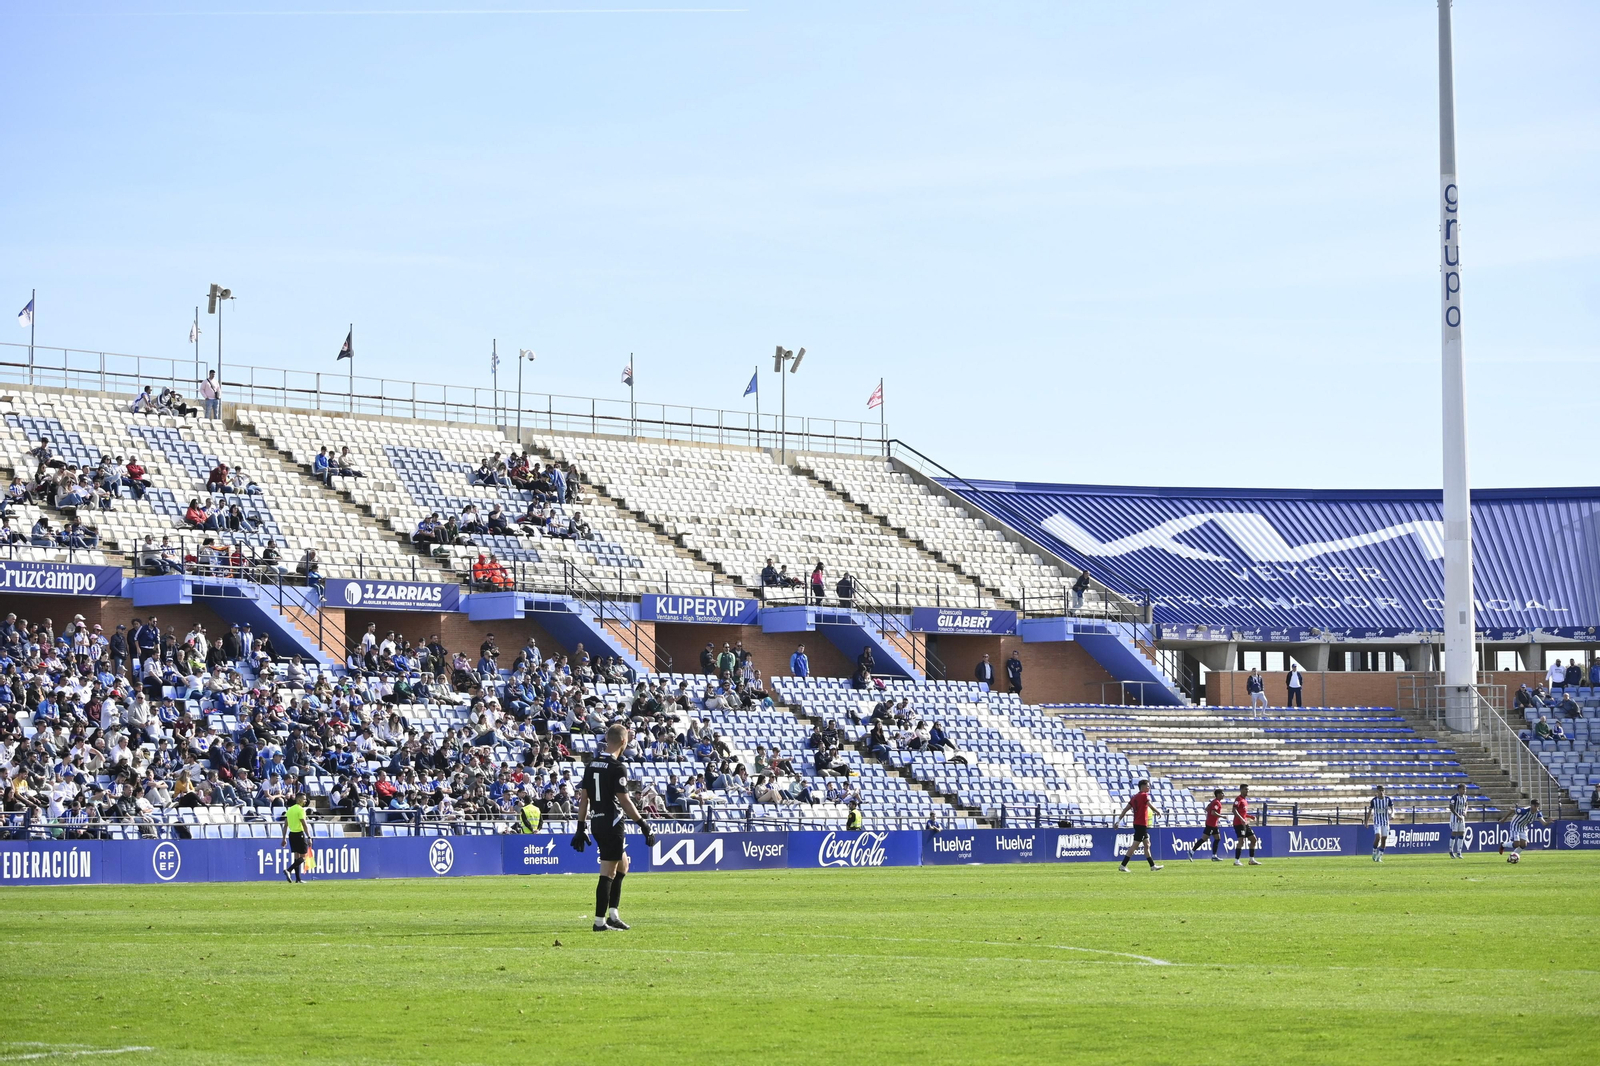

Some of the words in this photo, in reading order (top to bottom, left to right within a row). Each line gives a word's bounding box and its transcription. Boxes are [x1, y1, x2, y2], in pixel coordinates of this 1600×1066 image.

[1444, 183, 1461, 328] grupo
[1222, 565, 1388, 582] VEYSER
[656, 596, 745, 617] KLIPERVIP
[1422, 598, 1569, 612] OICIAL
[696, 615, 723, 623] Technology
[937, 615, 993, 628] GILABERT
[593, 772, 601, 802] 1
[523, 844, 544, 855] alter
[742, 840, 784, 861] Veyser
[933, 836, 972, 852] Huelva
[996, 834, 1033, 851] Huelva
[159, 851, 175, 860] RF
[652, 838, 724, 866] KIA
[1061, 848, 1091, 857] decoración
[0, 846, 91, 879] EDERACIÓN
[159, 861, 175, 871] EF
[523, 856, 559, 865] enersun
